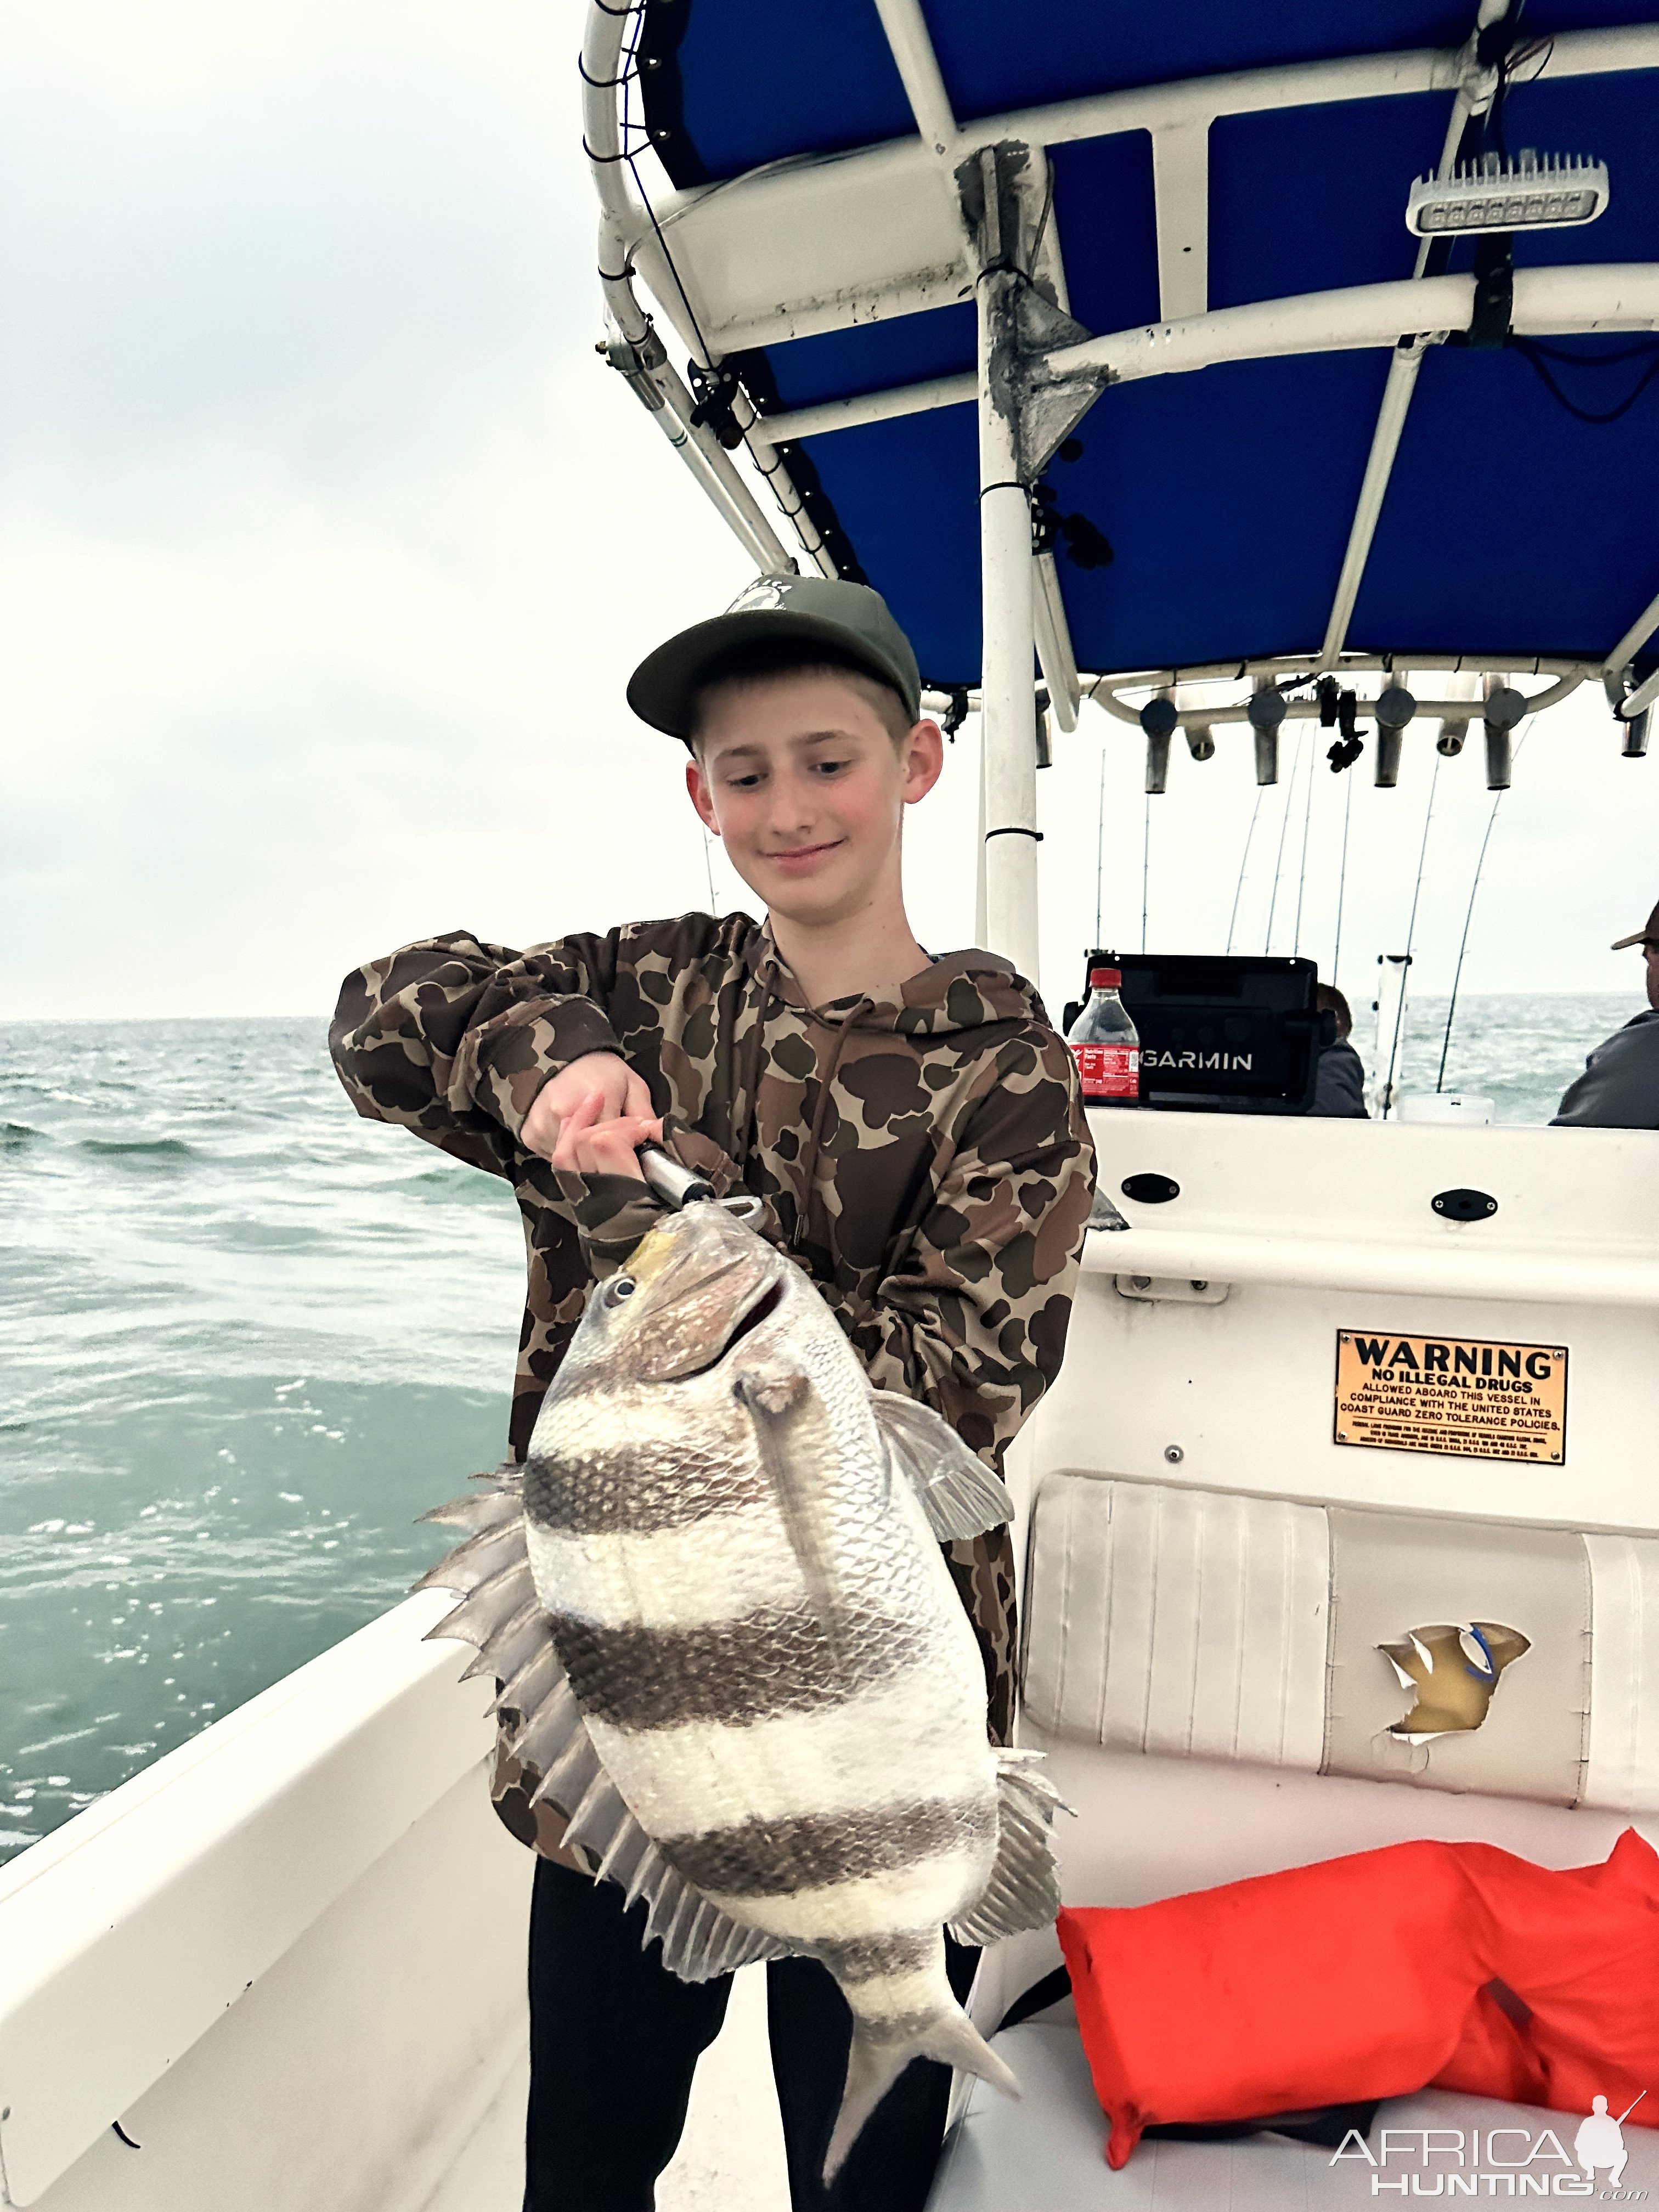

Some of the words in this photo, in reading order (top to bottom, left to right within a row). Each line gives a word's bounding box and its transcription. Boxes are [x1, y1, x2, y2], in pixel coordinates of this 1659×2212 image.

[1139, 1049, 1252, 1071] GARMIN
[1355, 1338, 1551, 1380] WARNING
[1372, 1369, 1394, 1381] NO
[1400, 1371, 1470, 1388] ILLEGAL
[1476, 1378, 1533, 1393] DRUGS
[1351, 1393, 1416, 1406] COMPLIANCE
[1420, 1399, 1444, 1409] WITH
[1448, 1402, 1468, 1410] THE
[1472, 1403, 1510, 1415] UNITED
[1513, 1407, 1552, 1418] STATES
[1363, 1383, 1412, 1395] ALLOWED
[1415, 1388, 1457, 1398] ABOARD
[1461, 1392, 1483, 1401] THIS
[1487, 1393, 1527, 1404] VESSEL
[1340, 1403, 1374, 1414] COAST
[1378, 1406, 1411, 1417] GUARD
[1415, 1410, 1442, 1420] ZERO
[1446, 1413, 1506, 1426] TOLERANCE
[1511, 1418, 1560, 1430] POLICIES.
